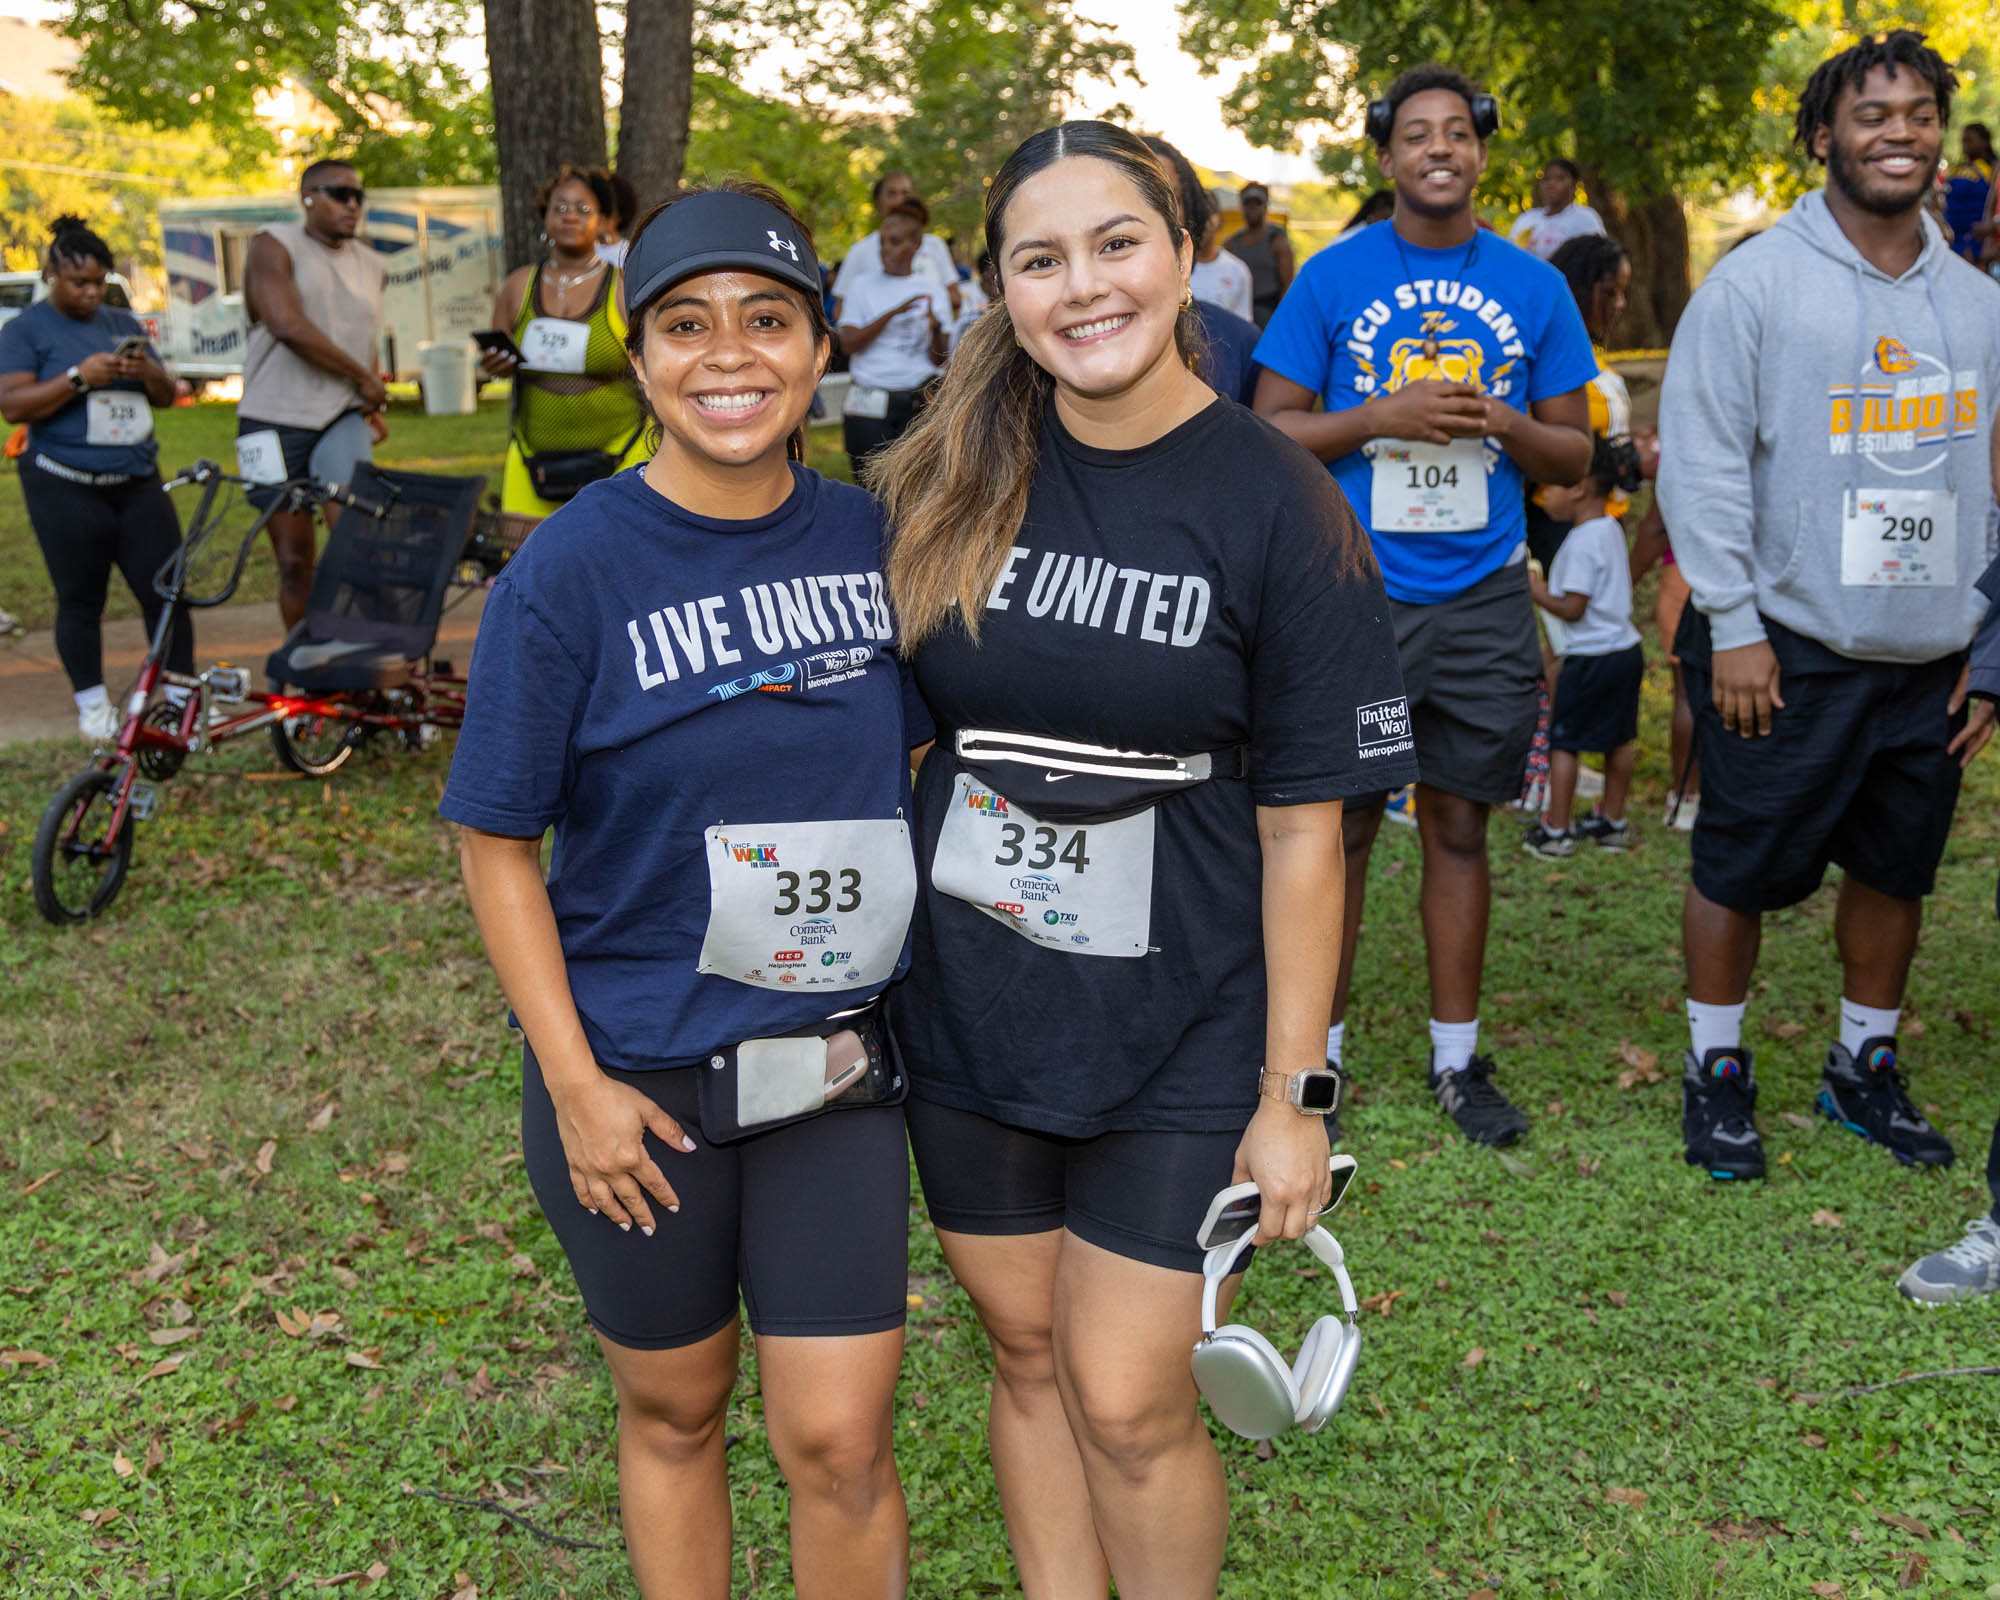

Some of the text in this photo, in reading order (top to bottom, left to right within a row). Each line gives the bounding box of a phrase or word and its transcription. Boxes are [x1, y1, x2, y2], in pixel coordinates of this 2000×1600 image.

[1394, 279, 1524, 358] STUDENT
[1407, 465, 1459, 489] 104
[1881, 517, 1933, 542] 290
[1026, 552, 1211, 648] UNITED
[627, 595, 742, 692] LIVE
[739, 571, 893, 655] UNITED
[807, 672, 847, 690] Metropolitan
[1360, 701, 1406, 725] United
[1378, 719, 1407, 736] Way
[1358, 740, 1415, 760] Metropolita
[968, 795, 1009, 812] WALK
[732, 847, 778, 862] WALK
[995, 822, 1090, 874] 334
[774, 868, 862, 916] 333
[1021, 890, 1048, 902] Bank
[1059, 912, 1078, 922] TXU
[800, 934, 826, 946] Bank
[835, 952, 852, 960] TXU
